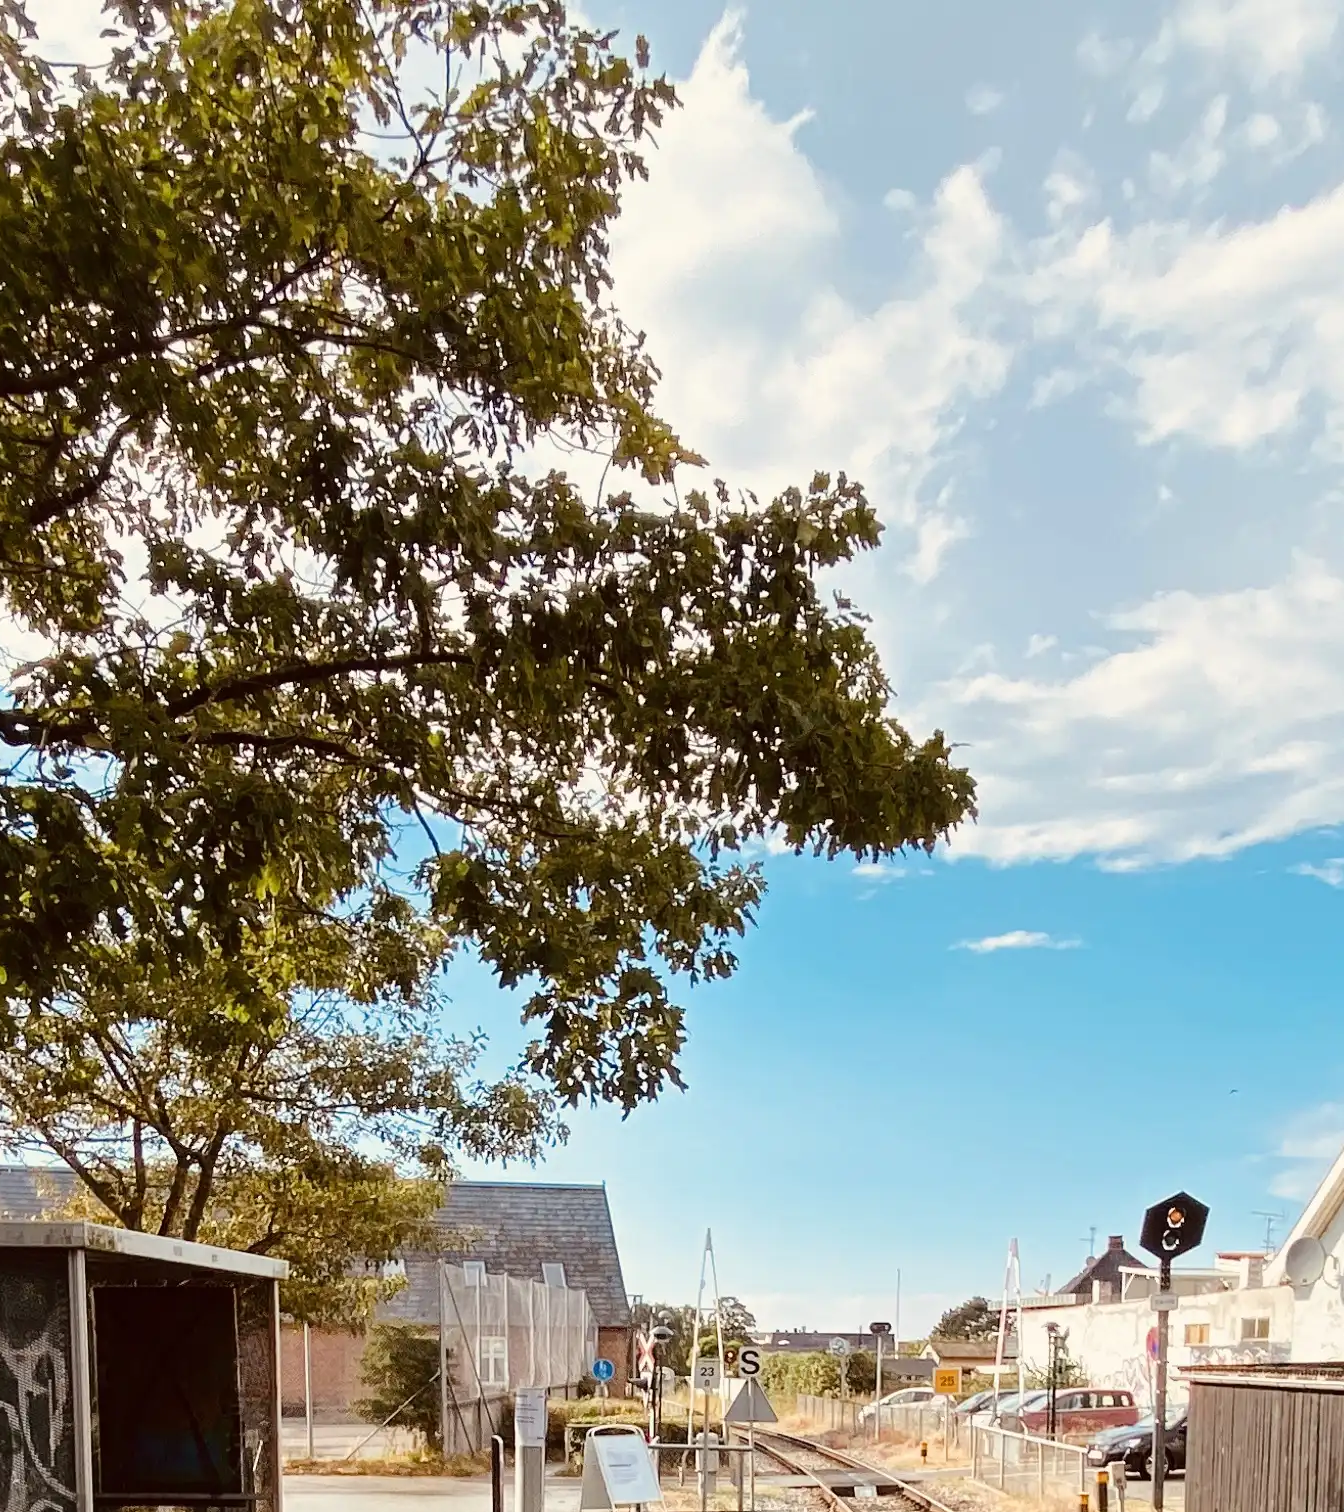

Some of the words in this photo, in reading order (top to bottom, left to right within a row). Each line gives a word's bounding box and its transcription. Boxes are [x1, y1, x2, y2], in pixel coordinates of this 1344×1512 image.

[741, 1351, 760, 1375] S
[700, 1367, 714, 1376] 23
[940, 1376, 954, 1386] 25
